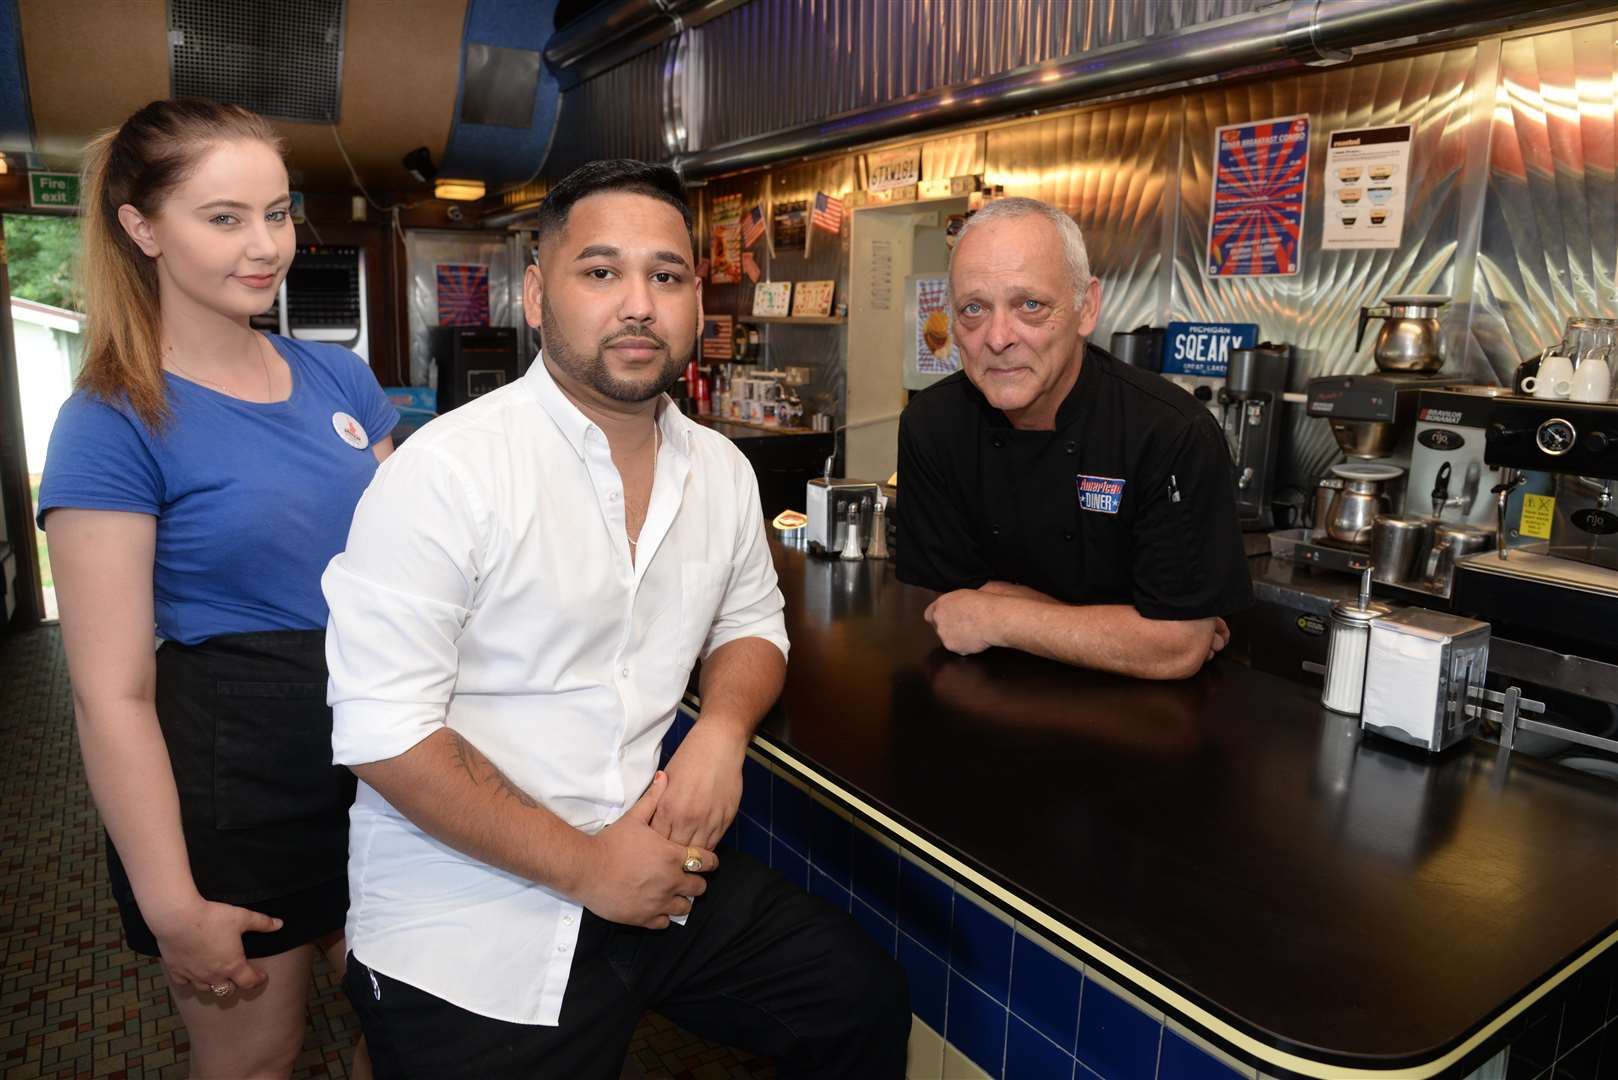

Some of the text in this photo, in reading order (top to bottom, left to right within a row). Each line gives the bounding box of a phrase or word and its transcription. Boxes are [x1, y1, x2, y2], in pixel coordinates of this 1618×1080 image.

[40, 177, 66, 189] Fire
[41, 191, 66, 202] exit
[1189, 326, 1231, 334] MICHIGAN
[1080, 479, 1121, 494] American
[1086, 492, 1112, 510] DINER
